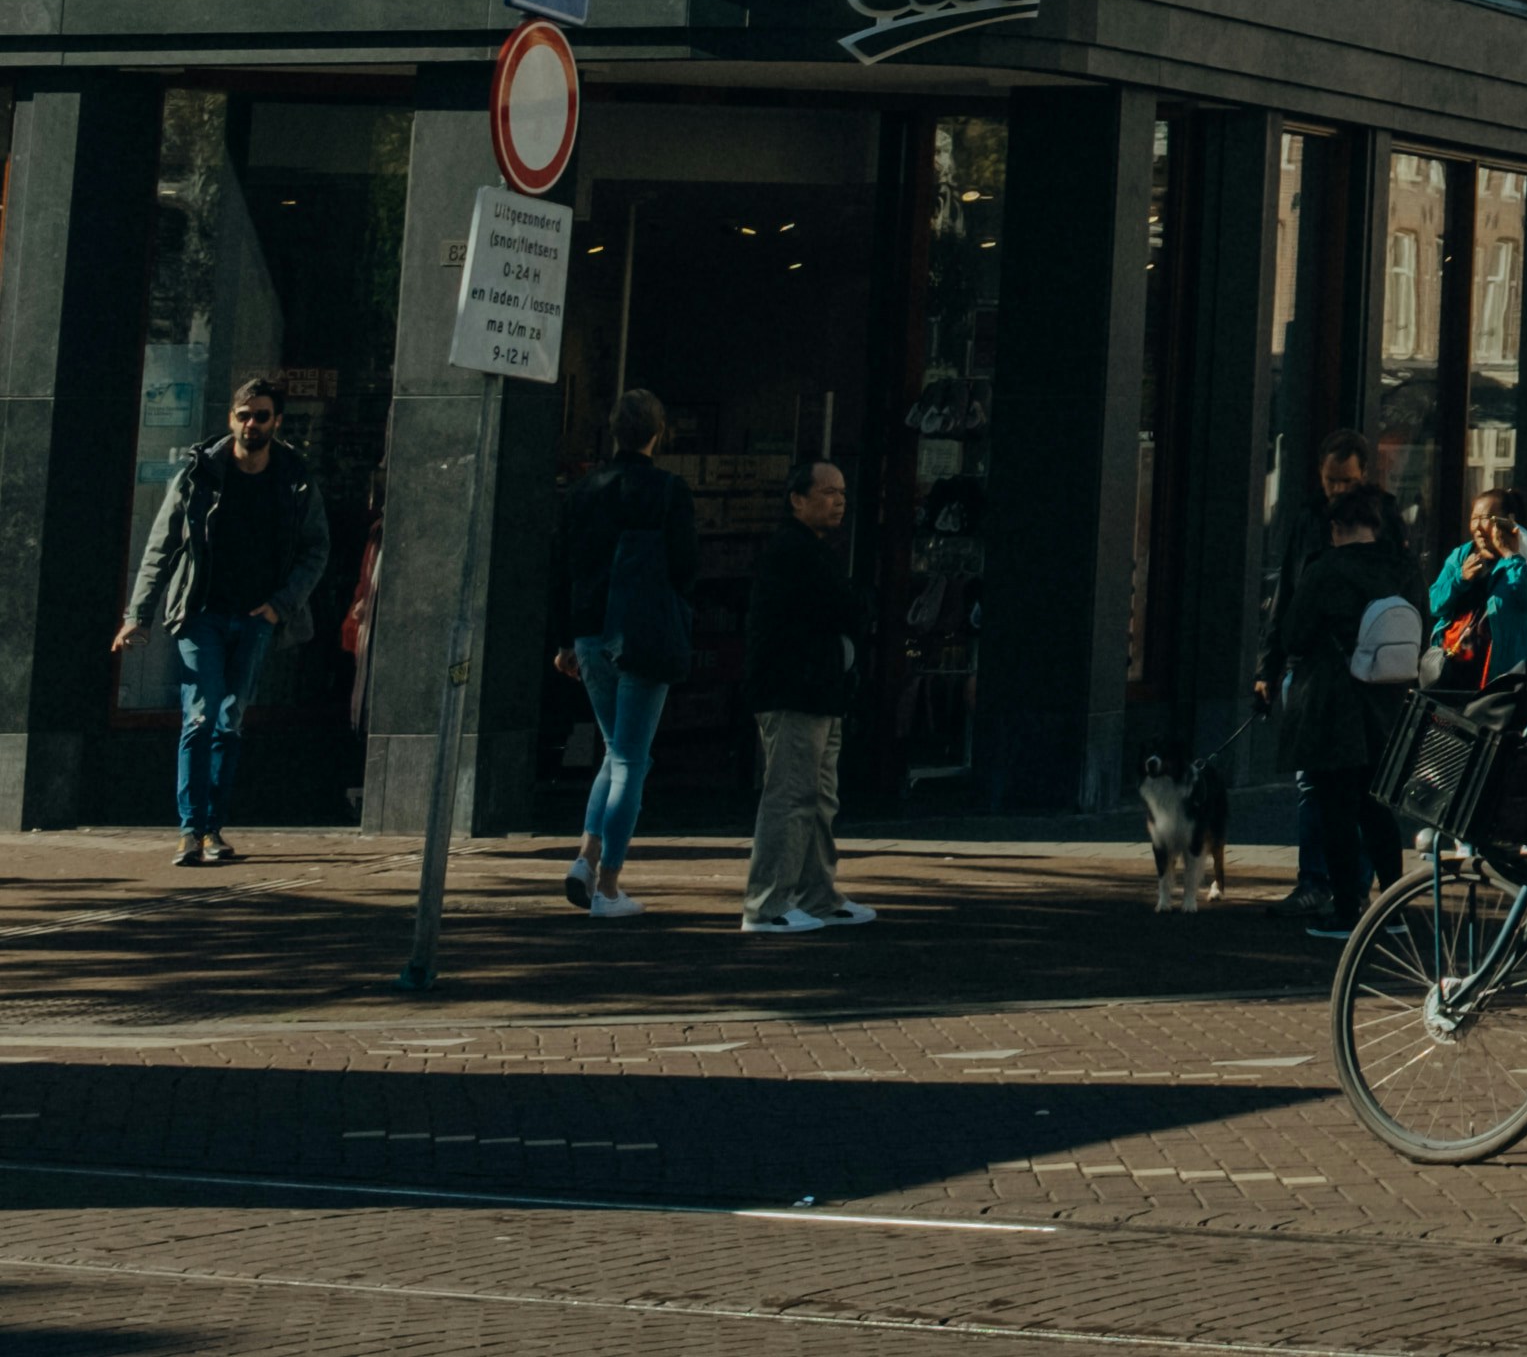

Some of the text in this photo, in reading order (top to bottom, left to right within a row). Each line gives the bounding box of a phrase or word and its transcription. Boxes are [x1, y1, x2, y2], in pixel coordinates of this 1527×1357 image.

[494, 203, 562, 233] Uitgezonderd
[489, 231, 559, 260] (snor)fietsers
[503, 262, 541, 284] 0-24 H
[471, 287, 485, 301] en
[489, 287, 520, 308] laden
[530, 297, 561, 318] lossen
[486, 318, 542, 341] ma t/m za
[492, 346, 530, 367] 9-12 H
